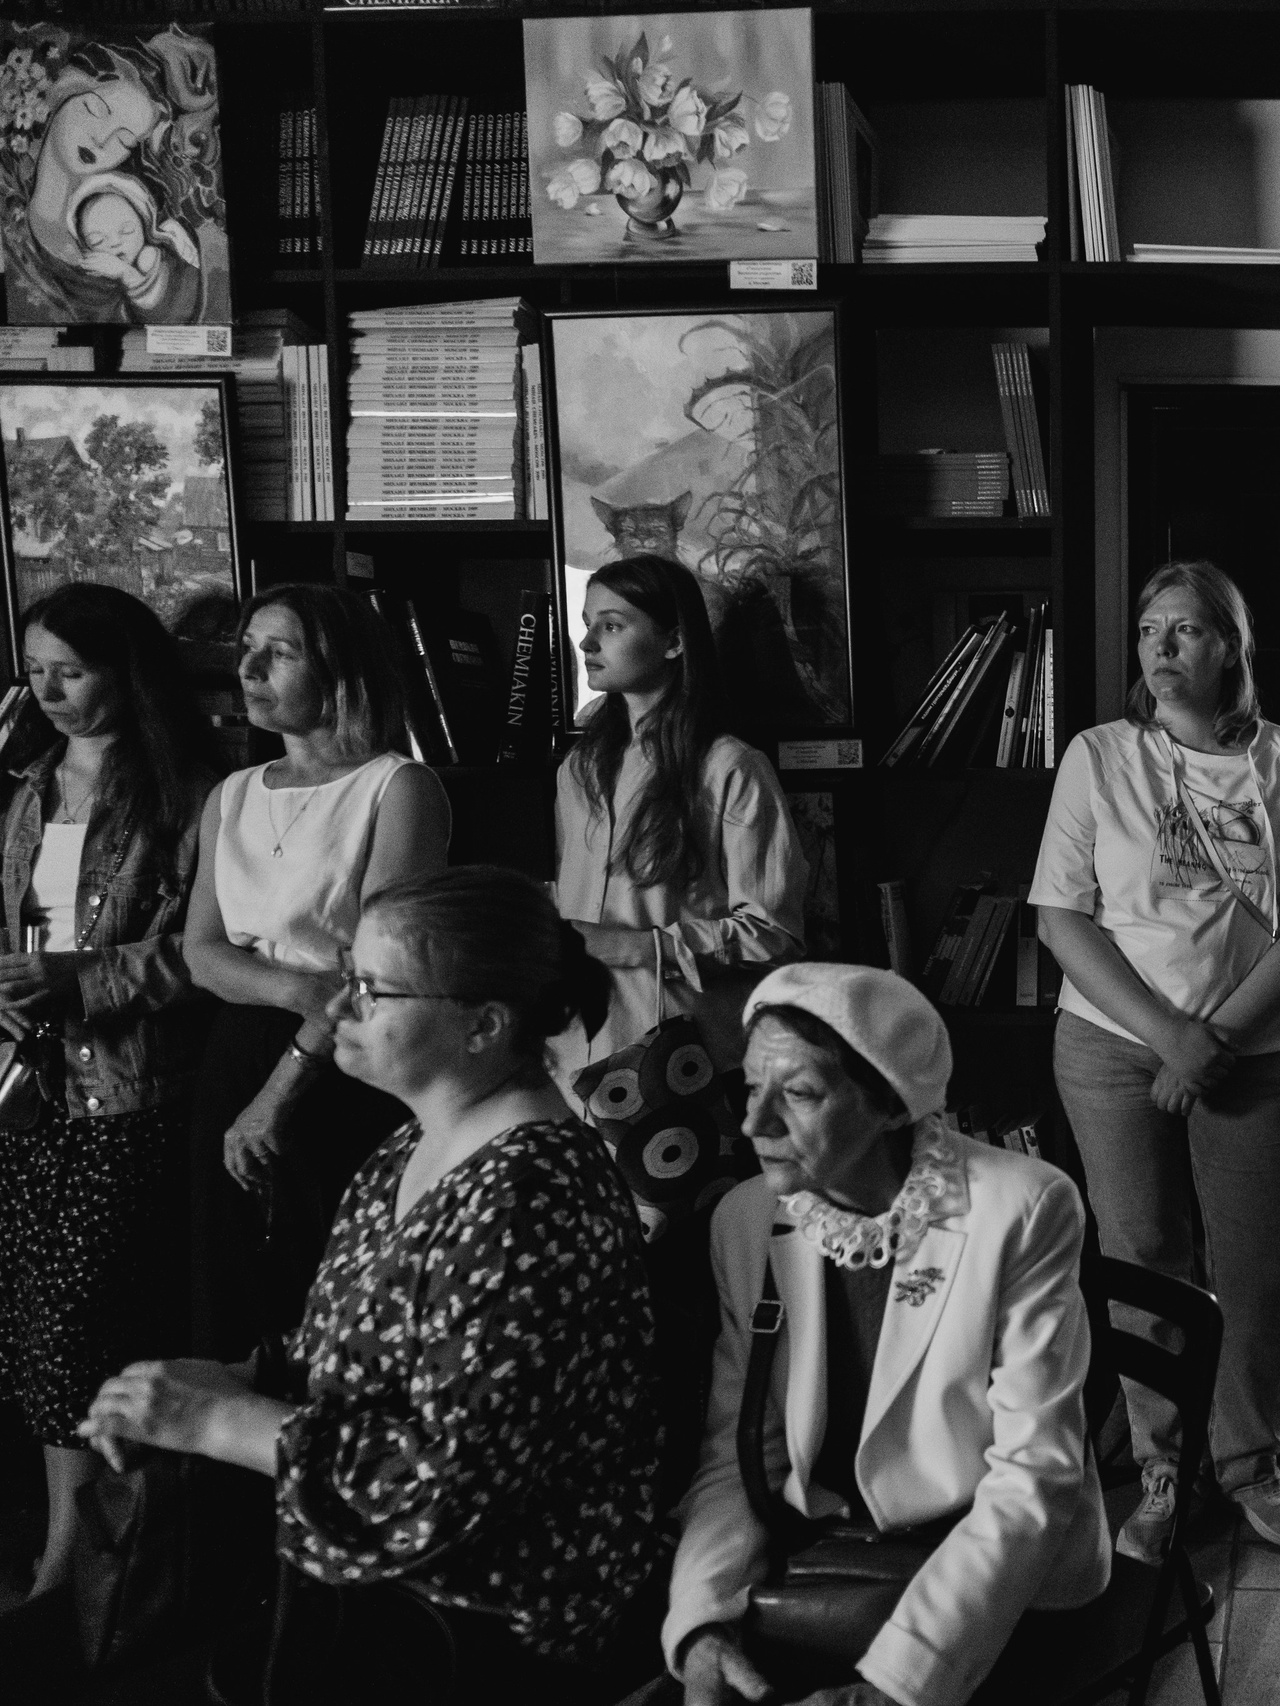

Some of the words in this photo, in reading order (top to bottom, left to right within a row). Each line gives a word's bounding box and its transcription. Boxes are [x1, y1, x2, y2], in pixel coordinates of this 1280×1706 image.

[379, 117, 393, 162] CHEMIAKIN
[388, 117, 402, 162] CHEMIAKIN
[396, 117, 410, 162] CHEMIAKIN
[411, 115, 425, 160] CHEMIAKIN
[420, 114, 433, 160] CHEMIAKIN
[429, 115, 443, 160] CHEMIAKIN
[440, 116, 454, 161] CHEMIAKIN
[450, 117, 464, 162] CHEMIAKIN
[467, 115, 476, 161] CHEMIAKIN
[476, 114, 485, 160] CHEMIAKIN
[485, 114, 494, 160] CHEMIAKIN
[495, 114, 503, 160] CHEMIAKIN
[503, 113, 511, 159] CHEMIAKIN
[512, 112, 520, 158] CHEMIAKIN
[377, 166, 385, 175] AT
[386, 166, 394, 175] AT
[394, 166, 402, 174] AT
[409, 164, 417, 173] AT
[418, 164, 425, 173] AT
[427, 164, 435, 173] AT
[437, 165, 445, 174] AT
[448, 166, 455, 175] AT
[466, 165, 473, 173] AT
[475, 164, 482, 173] AT
[485, 164, 492, 173] AT
[494, 164, 501, 173] AT
[503, 163, 509, 172] AT
[512, 162, 518, 171] AT
[520, 161, 527, 170] AT
[364, 240, 373, 254] 1994
[373, 240, 382, 254] 1994
[381, 239, 390, 254] 1994
[396, 238, 405, 253] 1994
[405, 238, 413, 253] 1994
[413, 238, 422, 253] 1994
[423, 239, 432, 253] 1994
[433, 240, 442, 254] 1994
[507, 613, 536, 727] CHEMIAKIN
